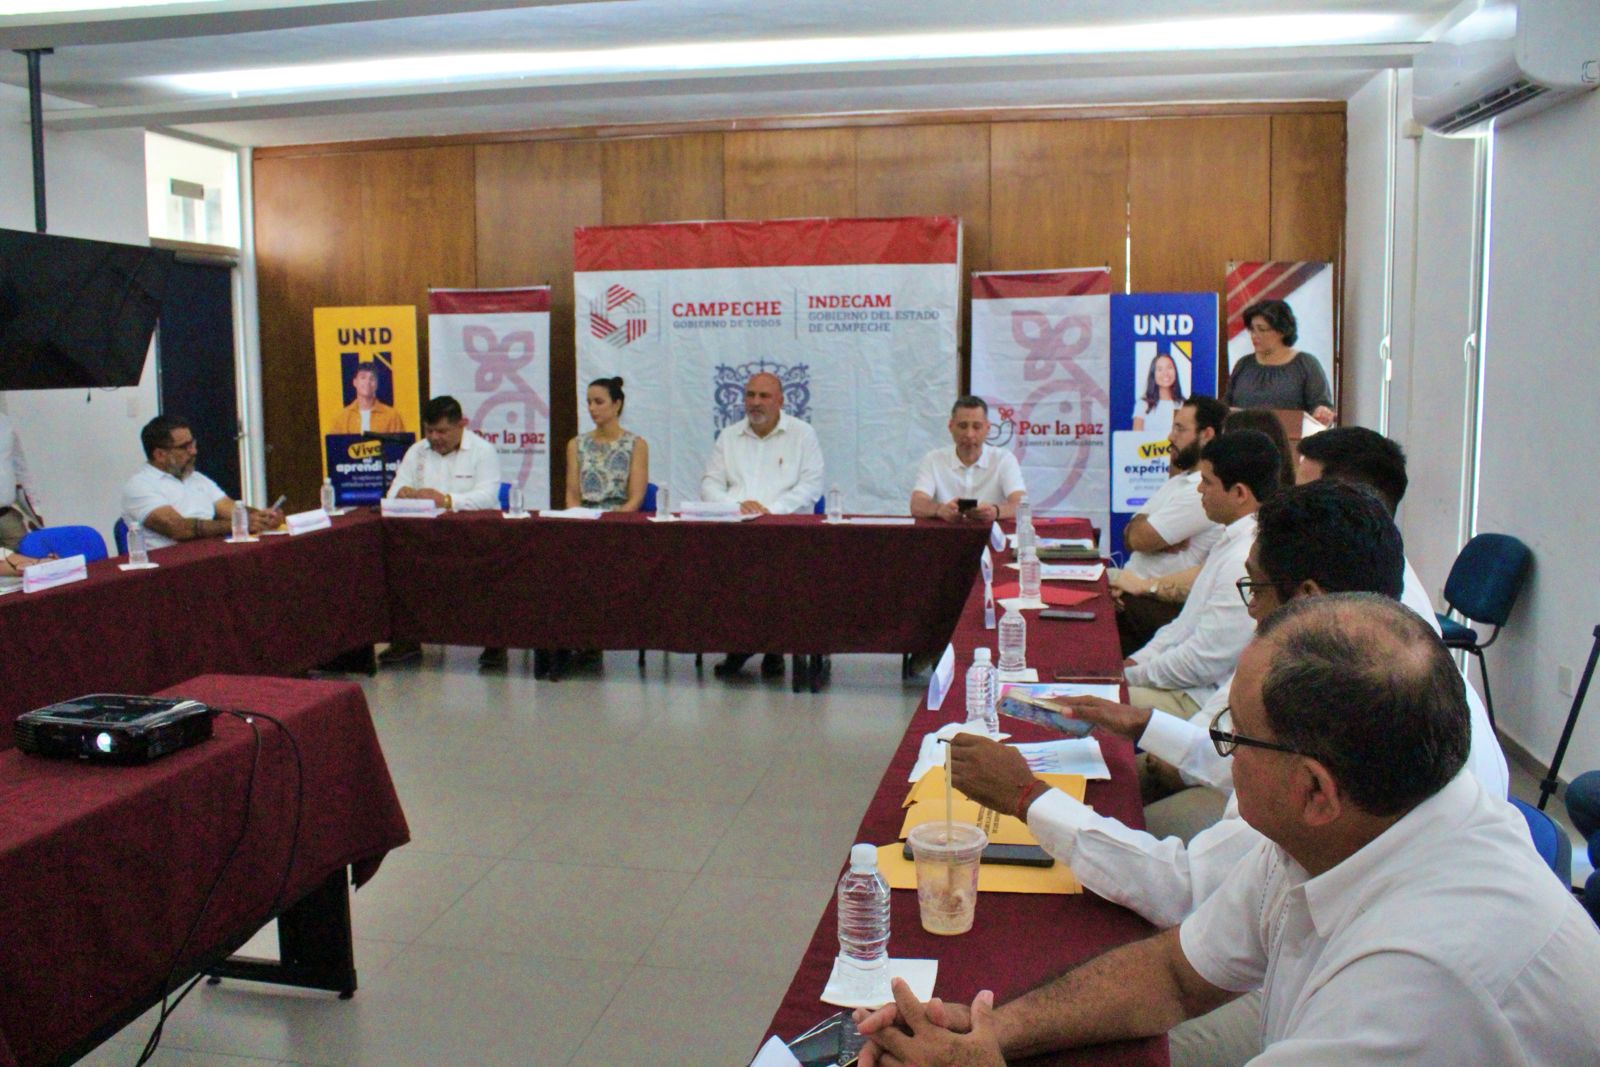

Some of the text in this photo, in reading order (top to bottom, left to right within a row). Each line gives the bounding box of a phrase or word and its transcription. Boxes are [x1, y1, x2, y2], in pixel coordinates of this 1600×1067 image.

[672, 300, 782, 317] CAMPECHE
[808, 294, 892, 309] INDECAM
[808, 309, 941, 321] GOBIERNO DEL ESTADO
[672, 319, 782, 329] GOBIERNO DE TODOS
[808, 321, 892, 333] DE CAMPECHE
[1134, 313, 1194, 336] UNID
[337, 326, 393, 346] UNID
[1018, 419, 1104, 440] Por la paz
[503, 429, 517, 444] la
[520, 432, 546, 448] paz
